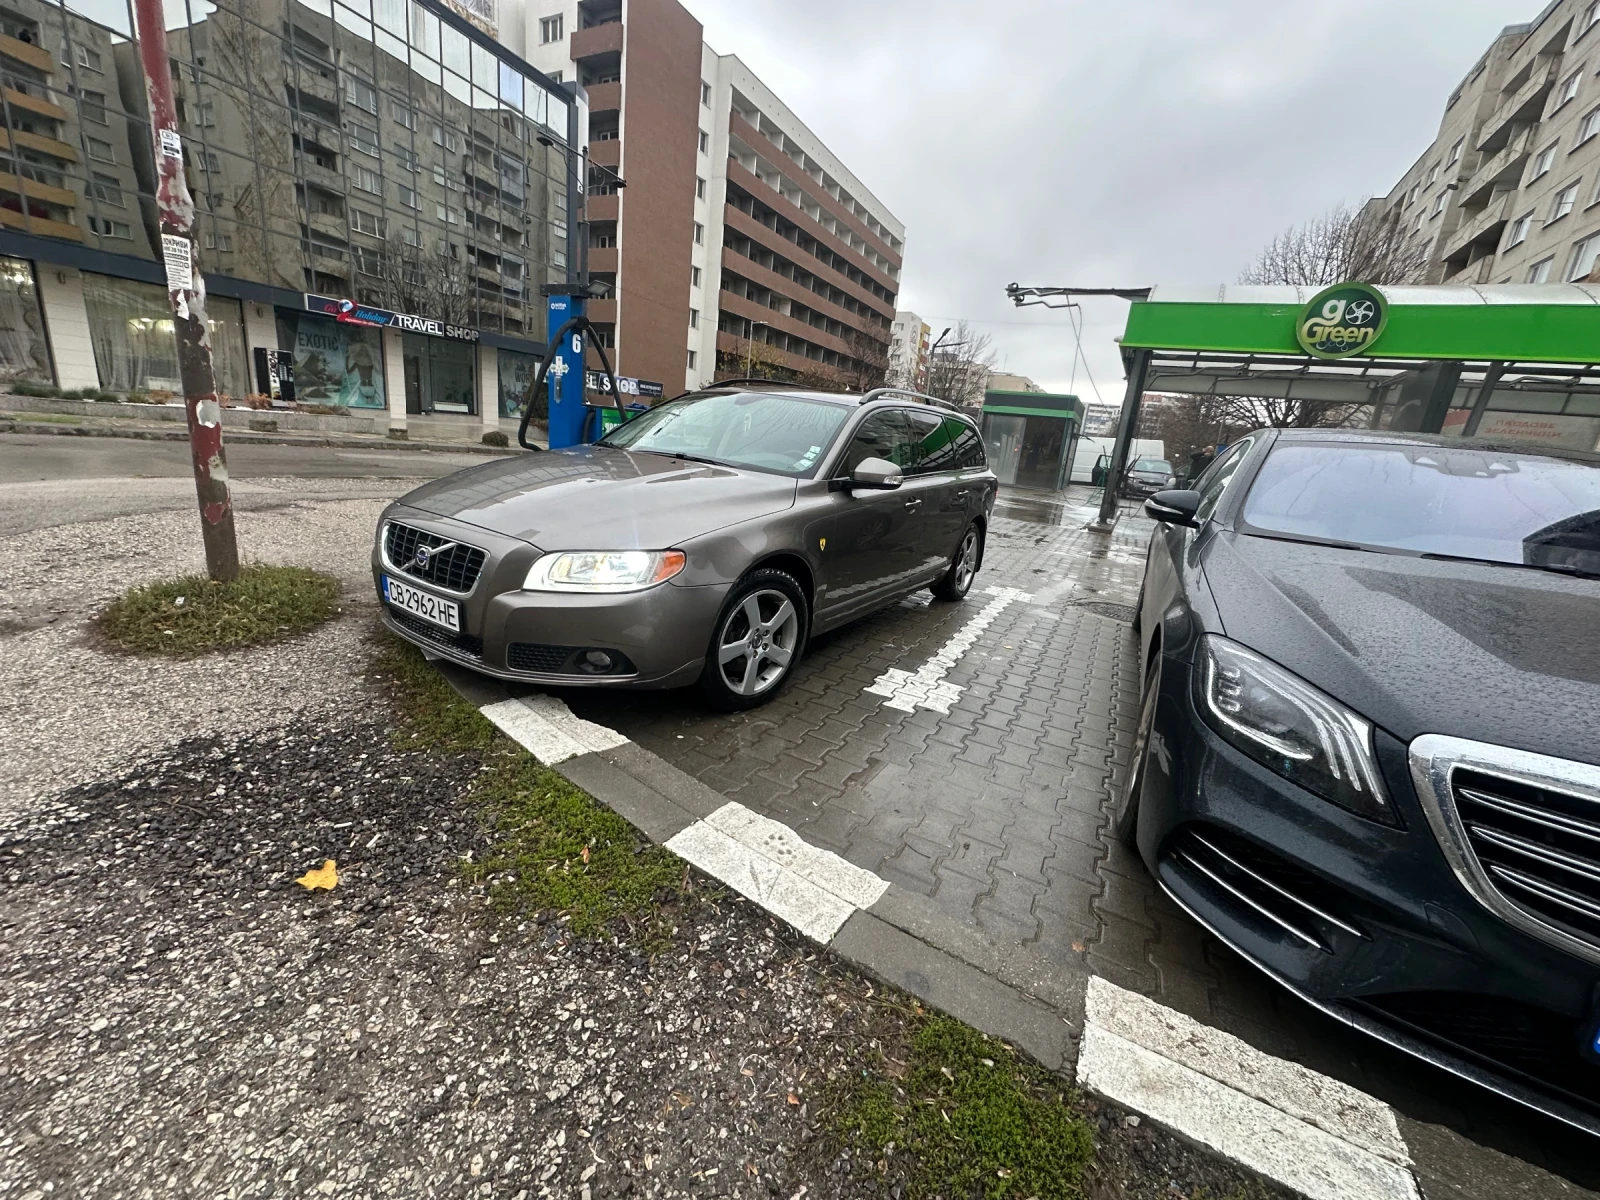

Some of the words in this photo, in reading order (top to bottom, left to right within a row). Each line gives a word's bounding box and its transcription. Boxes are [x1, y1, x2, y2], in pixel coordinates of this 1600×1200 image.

[355, 310, 387, 324] Holiday
[396, 314, 442, 335] TRAVEL
[445, 325, 479, 341] SHOP
[1301, 317, 1374, 344] Green
[298, 331, 339, 351] EXOTIC
[572, 333, 582, 354] 6
[406, 588, 437, 619] 2962
